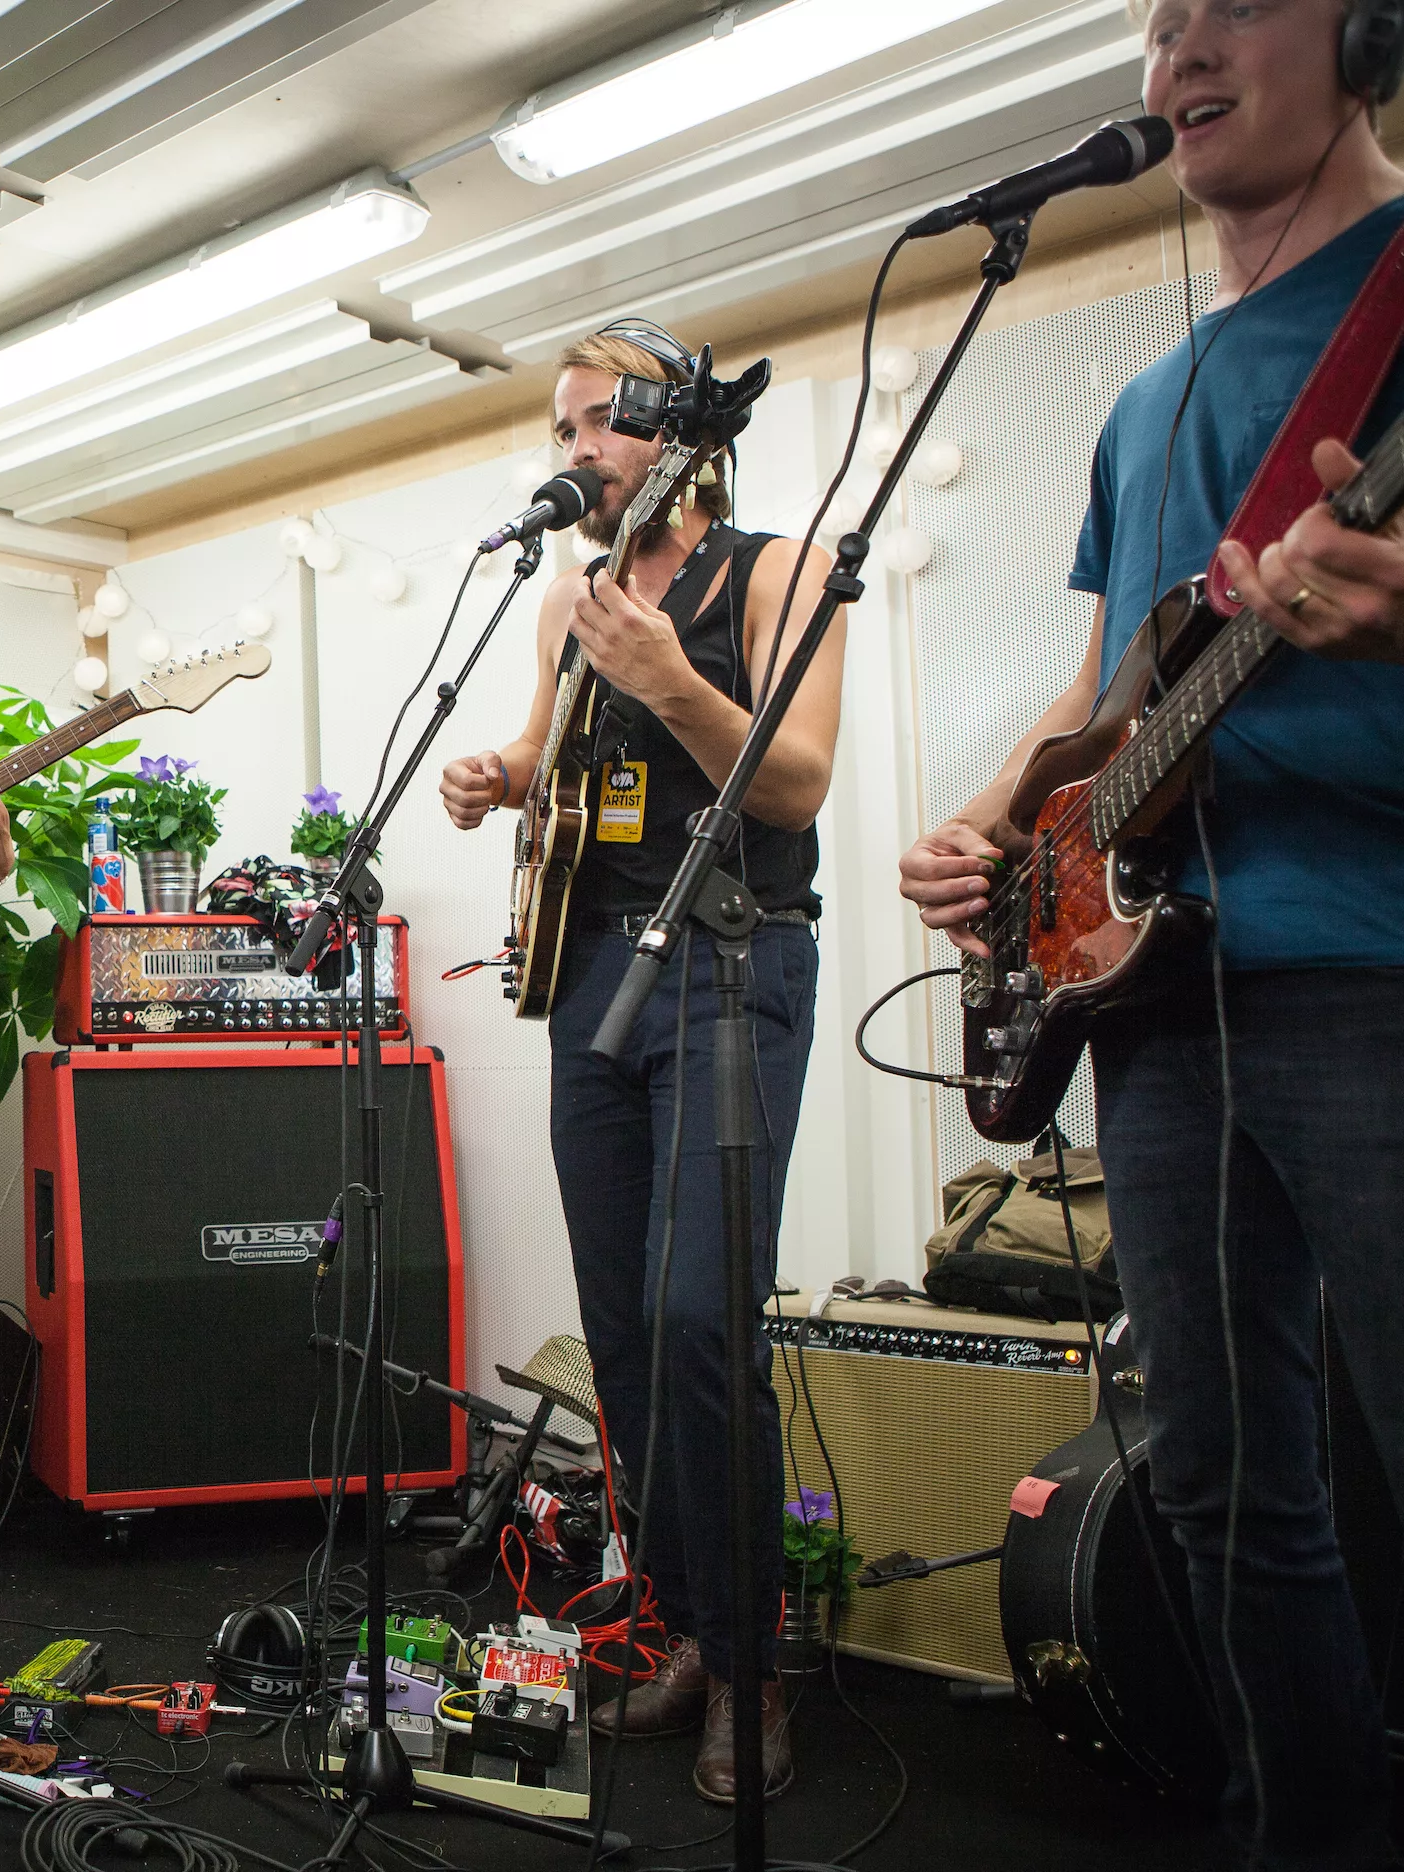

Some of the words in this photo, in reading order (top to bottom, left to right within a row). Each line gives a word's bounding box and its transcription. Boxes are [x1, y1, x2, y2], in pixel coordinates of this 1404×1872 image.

[603, 794, 642, 807] ARTIST
[222, 955, 272, 965] MESA
[212, 1226, 321, 1246] MESA
[231, 1249, 307, 1260] ENGINEERING
[999, 1339, 1039, 1354] Twin
[168, 1712, 199, 1720] electronic
[514, 1704, 531, 1719] RAT
